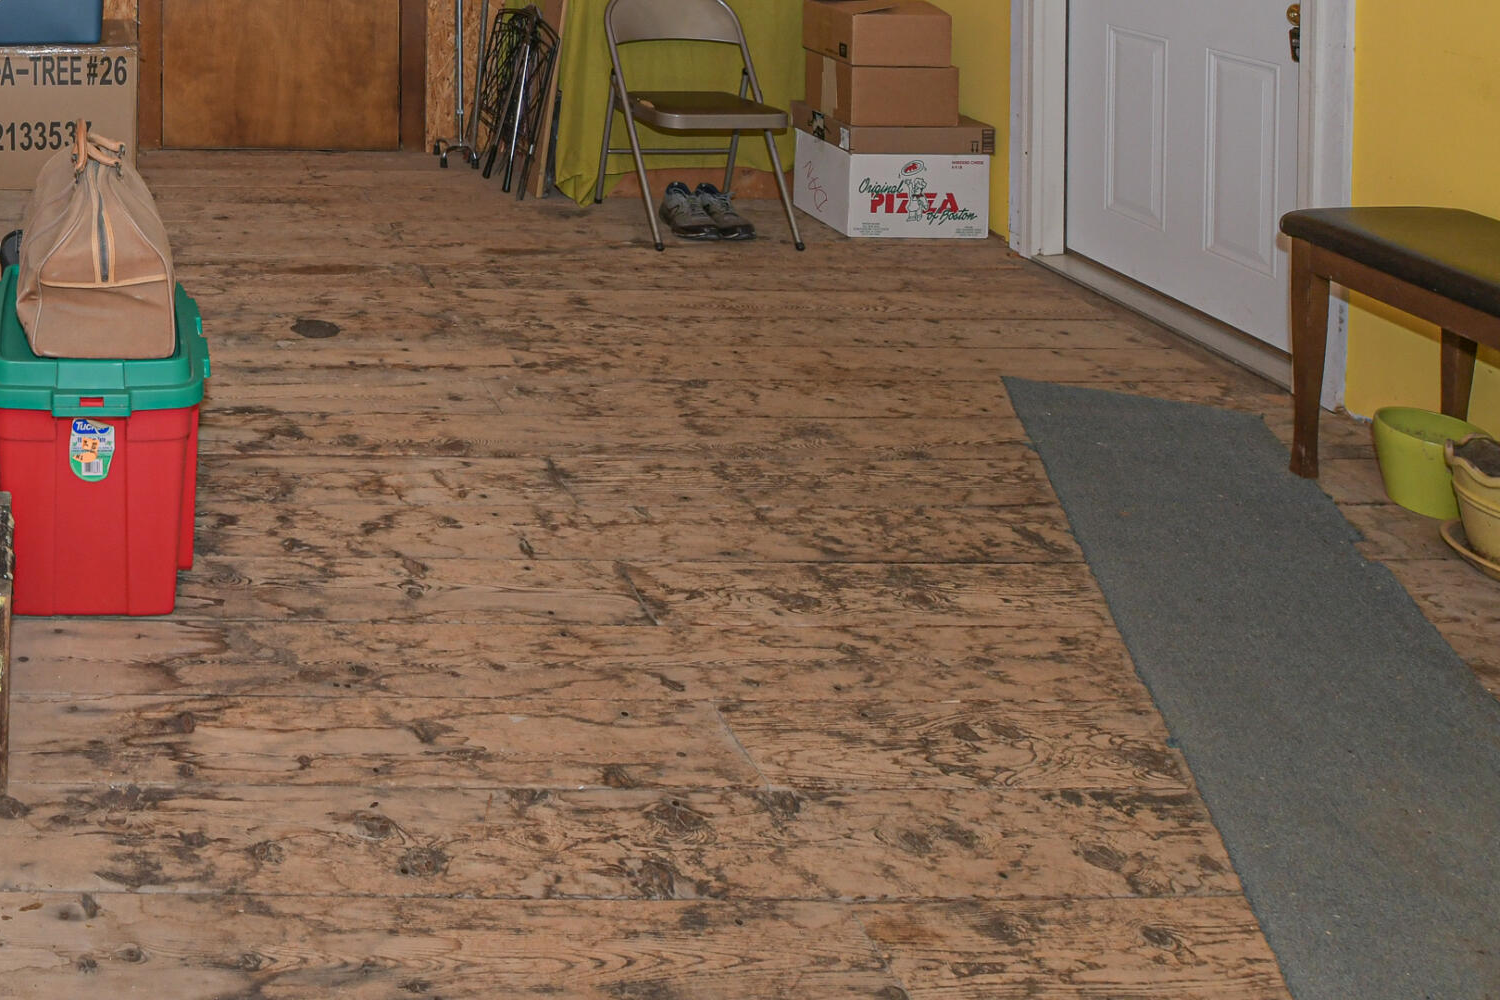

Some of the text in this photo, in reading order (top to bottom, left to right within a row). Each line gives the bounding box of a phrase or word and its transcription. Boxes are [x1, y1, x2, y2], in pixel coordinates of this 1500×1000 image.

[87, 56, 128, 86] #26
[858, 177, 905, 198] Original
[870, 192, 959, 213] PIZZA
[926, 208, 978, 225] of Boston
